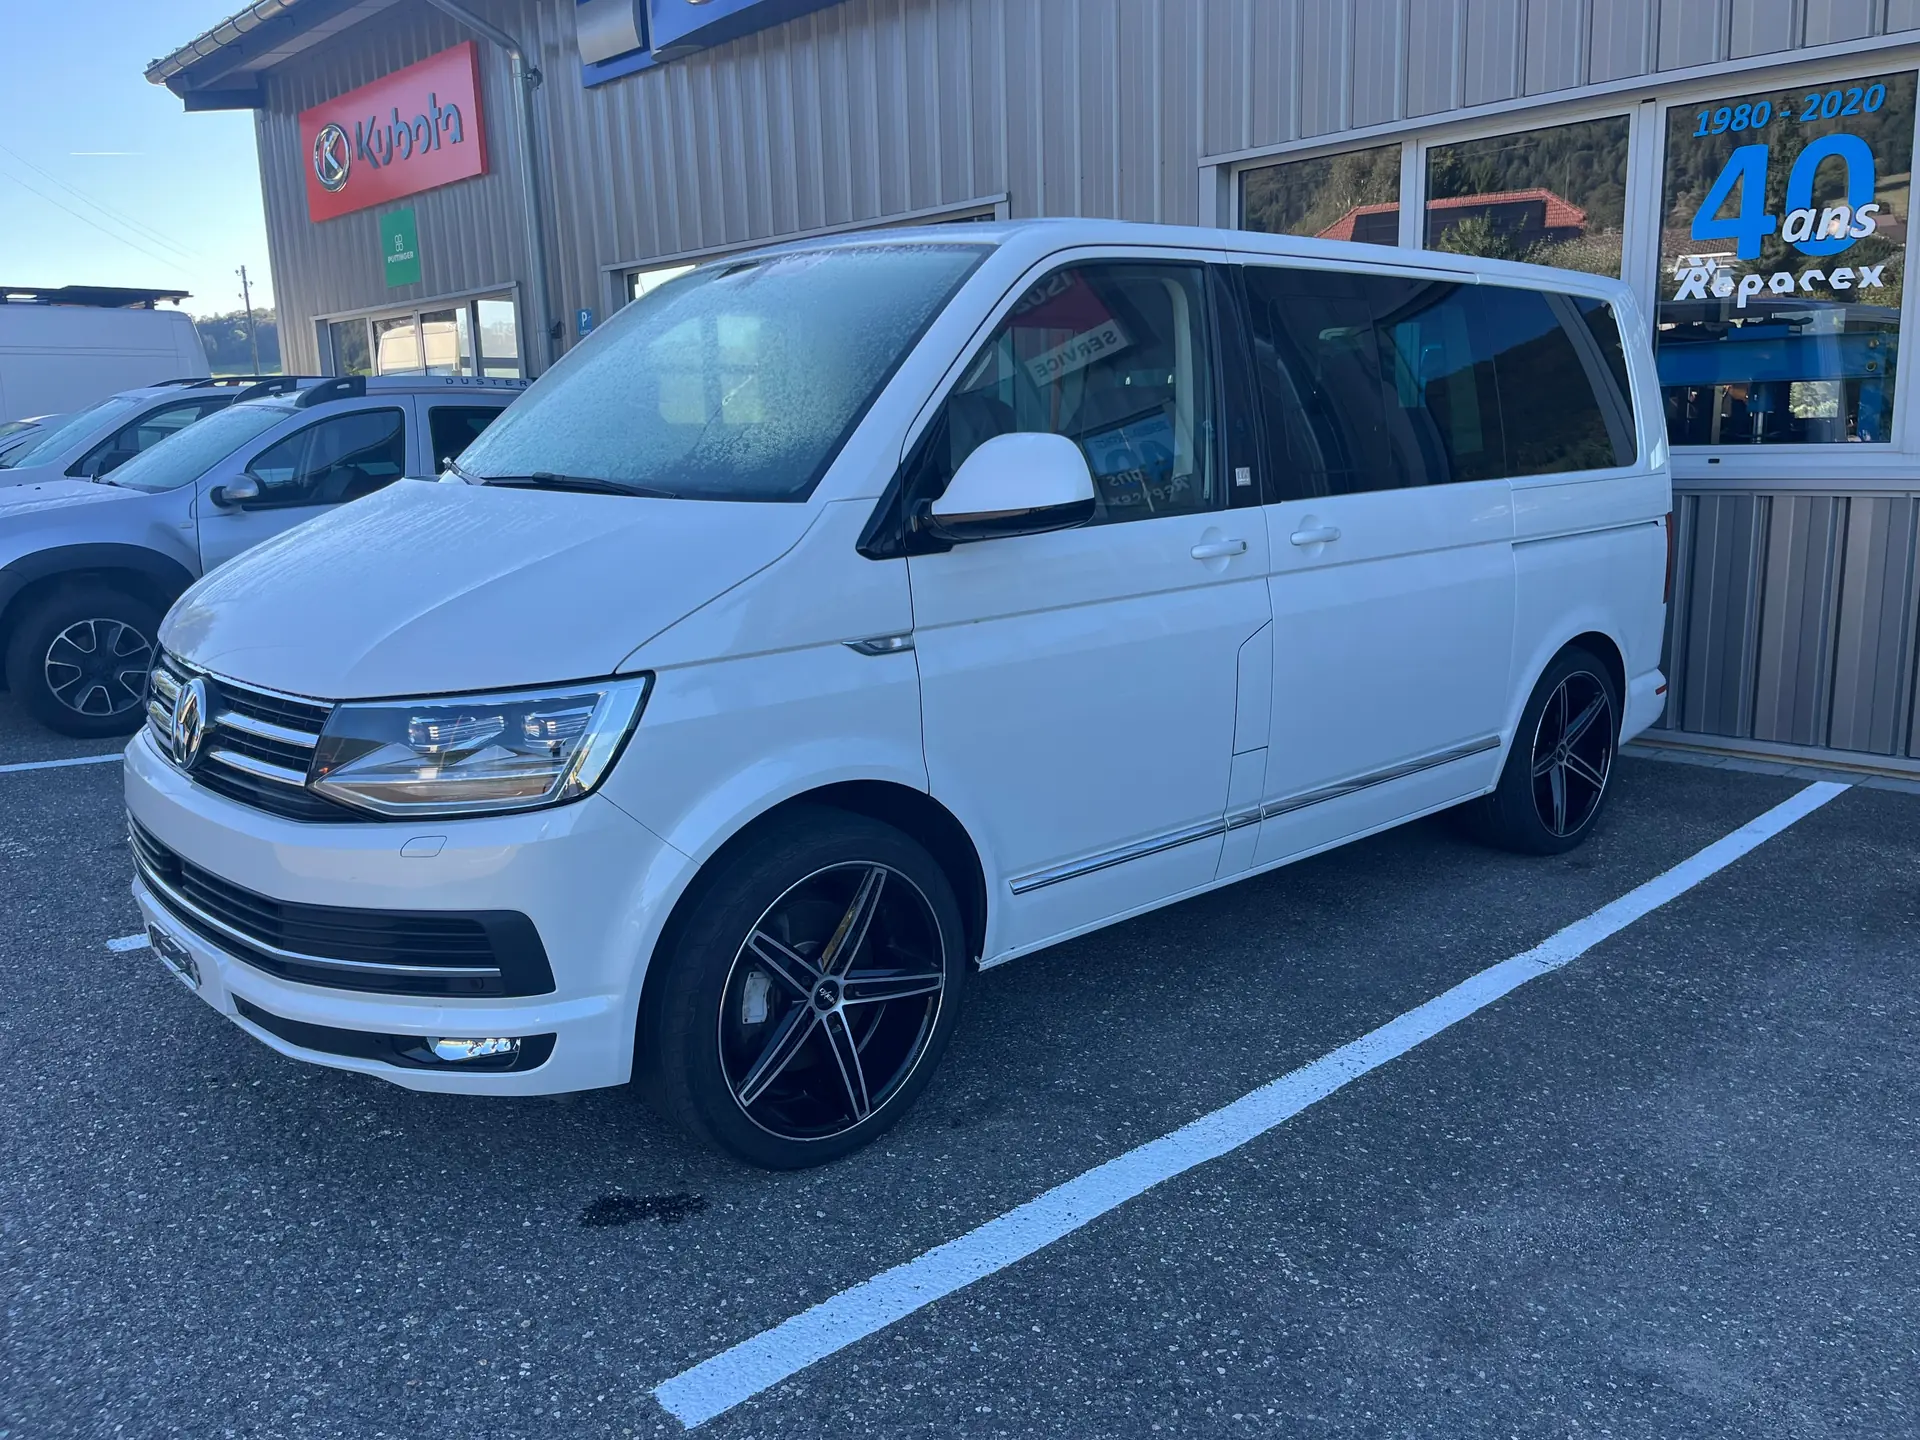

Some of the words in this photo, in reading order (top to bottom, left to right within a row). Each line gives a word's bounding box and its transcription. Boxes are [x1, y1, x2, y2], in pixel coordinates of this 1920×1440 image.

[354, 92, 464, 169] Kubota
[1692, 100, 1772, 138] 1980
[1799, 83, 1886, 122] 2020
[1691, 133, 1876, 260] 40
[1782, 203, 1880, 243] ans
[1673, 260, 1885, 308] Reparex
[581, 311, 588, 327] P
[445, 378, 528, 388] DUSTER
